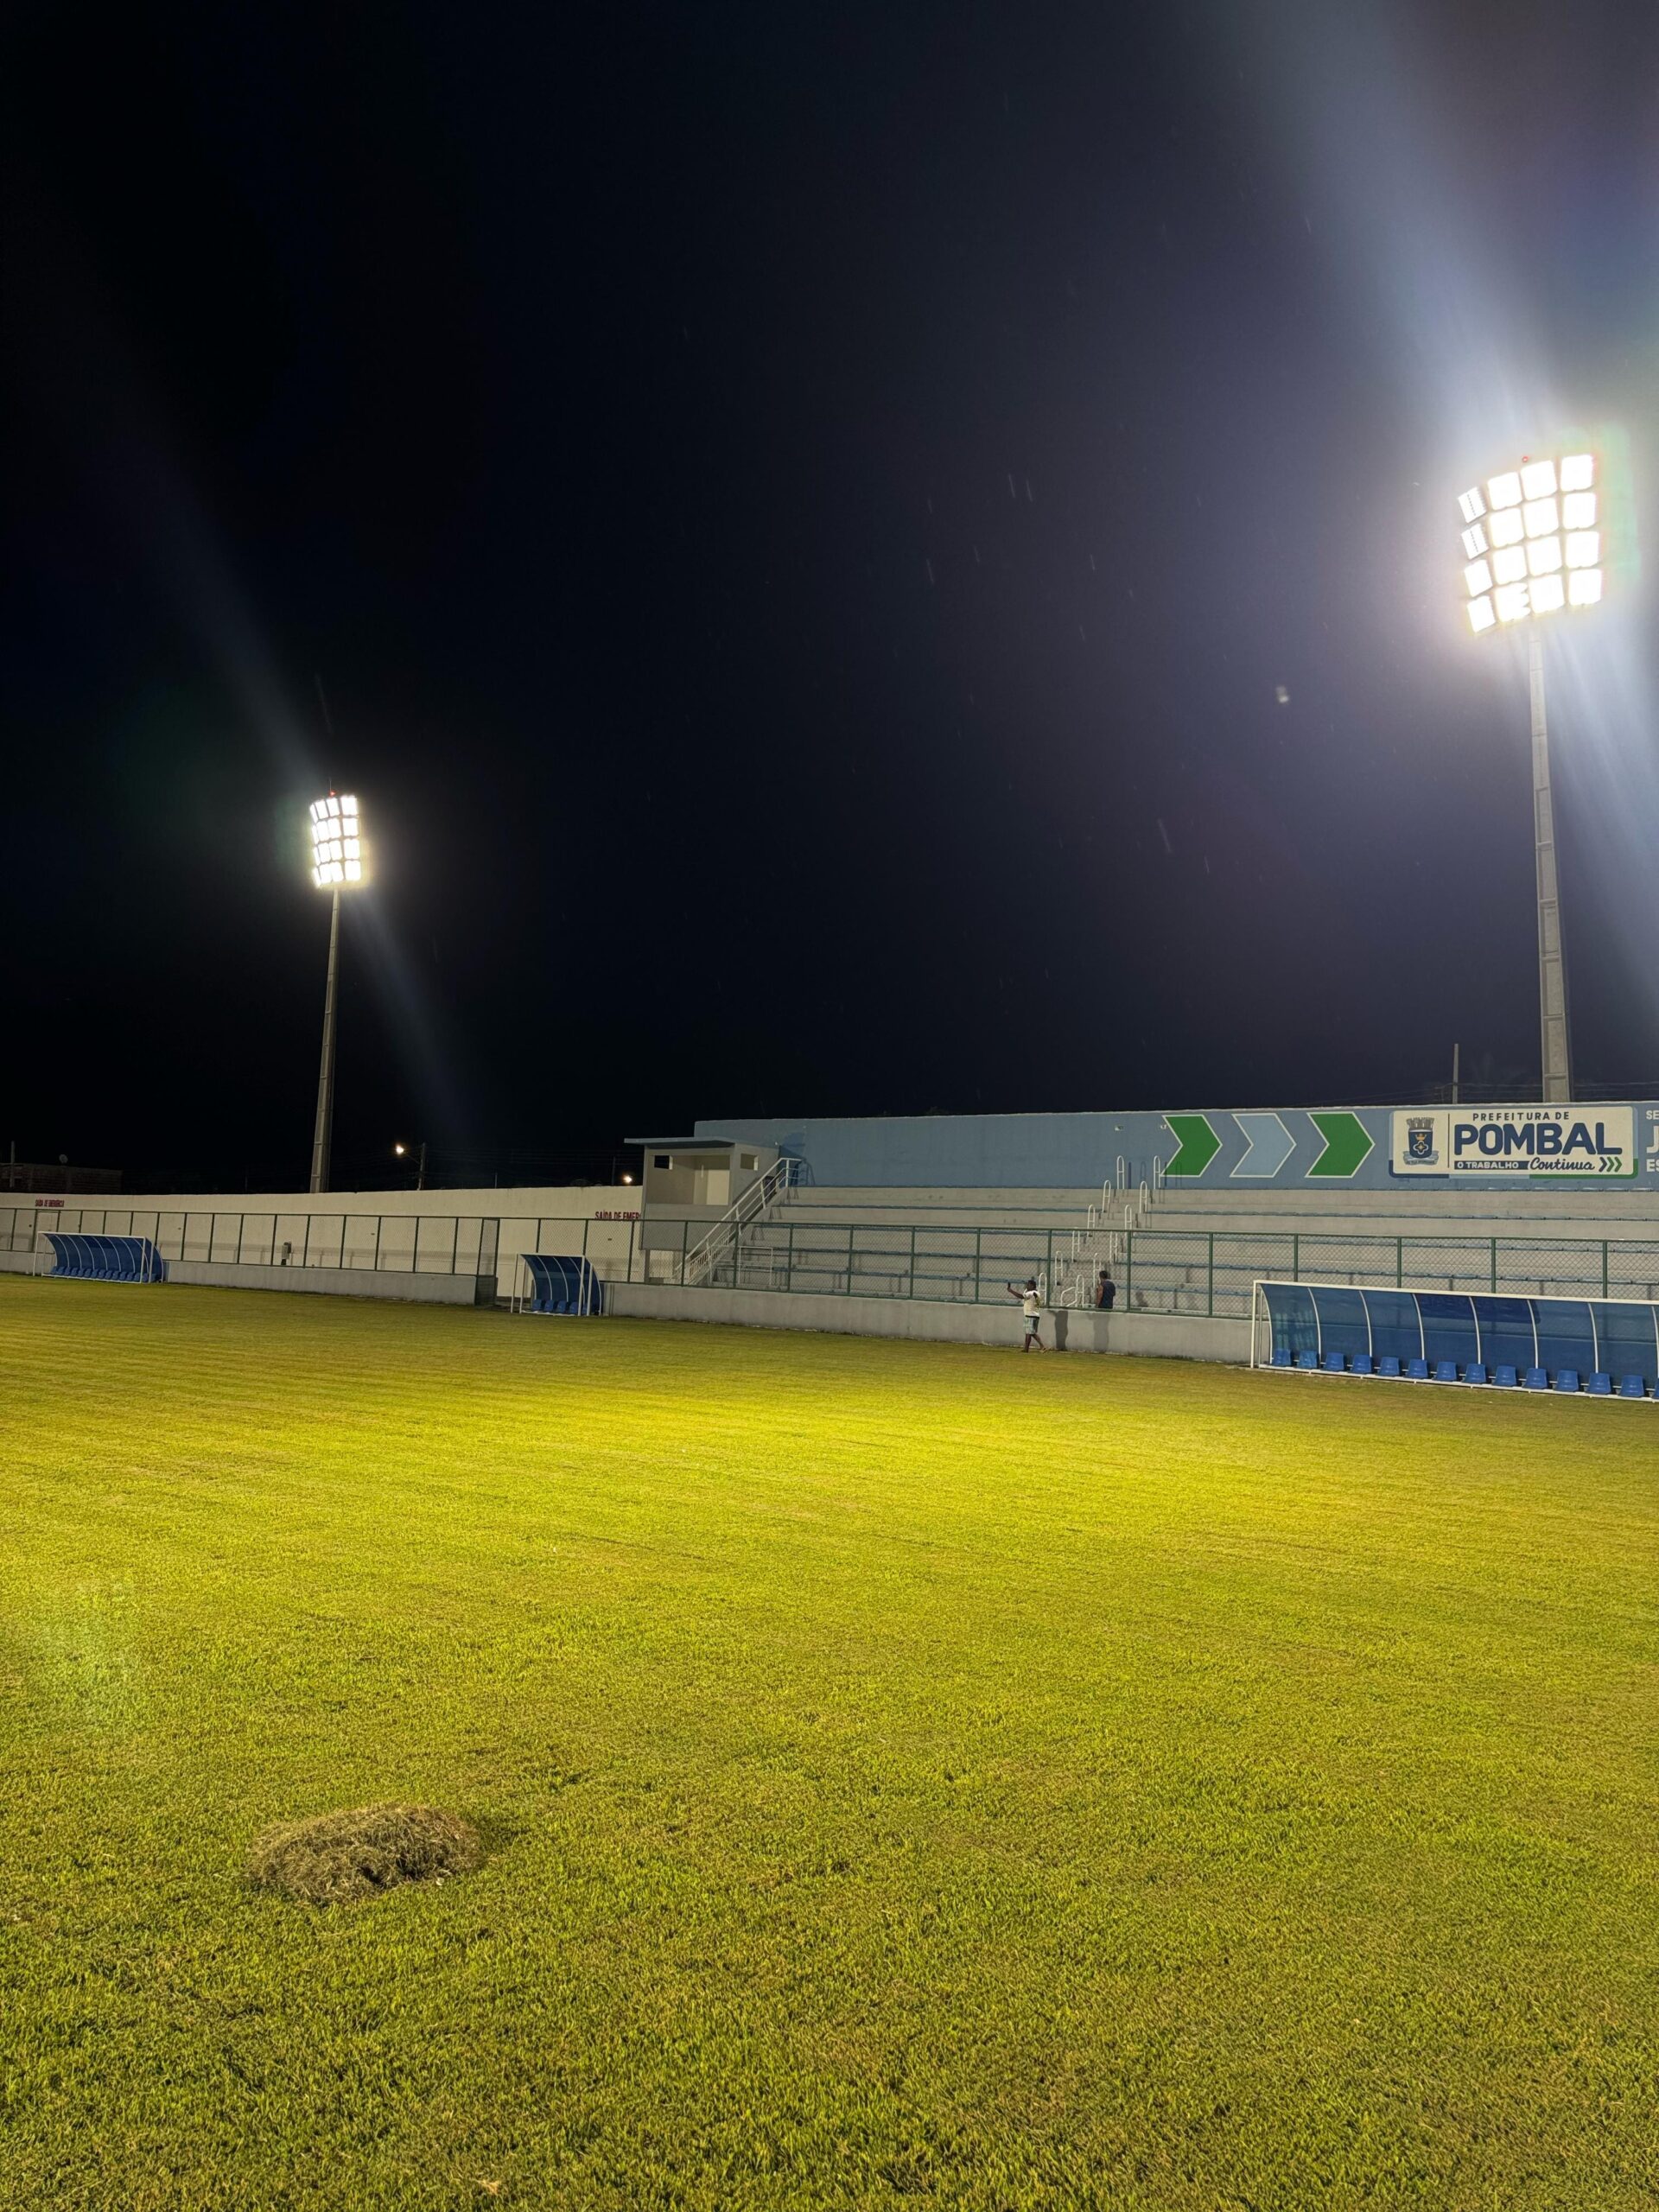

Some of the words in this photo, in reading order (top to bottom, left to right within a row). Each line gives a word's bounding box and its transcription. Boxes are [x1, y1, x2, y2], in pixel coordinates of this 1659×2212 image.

[1473, 1112, 1550, 1122] PREFEITURA
[1555, 1111, 1569, 1120] DE
[1454, 1122, 1623, 1155] POMBAL
[1529, 1156, 1595, 1171] Continua
[614, 1211, 621, 1219] DE
